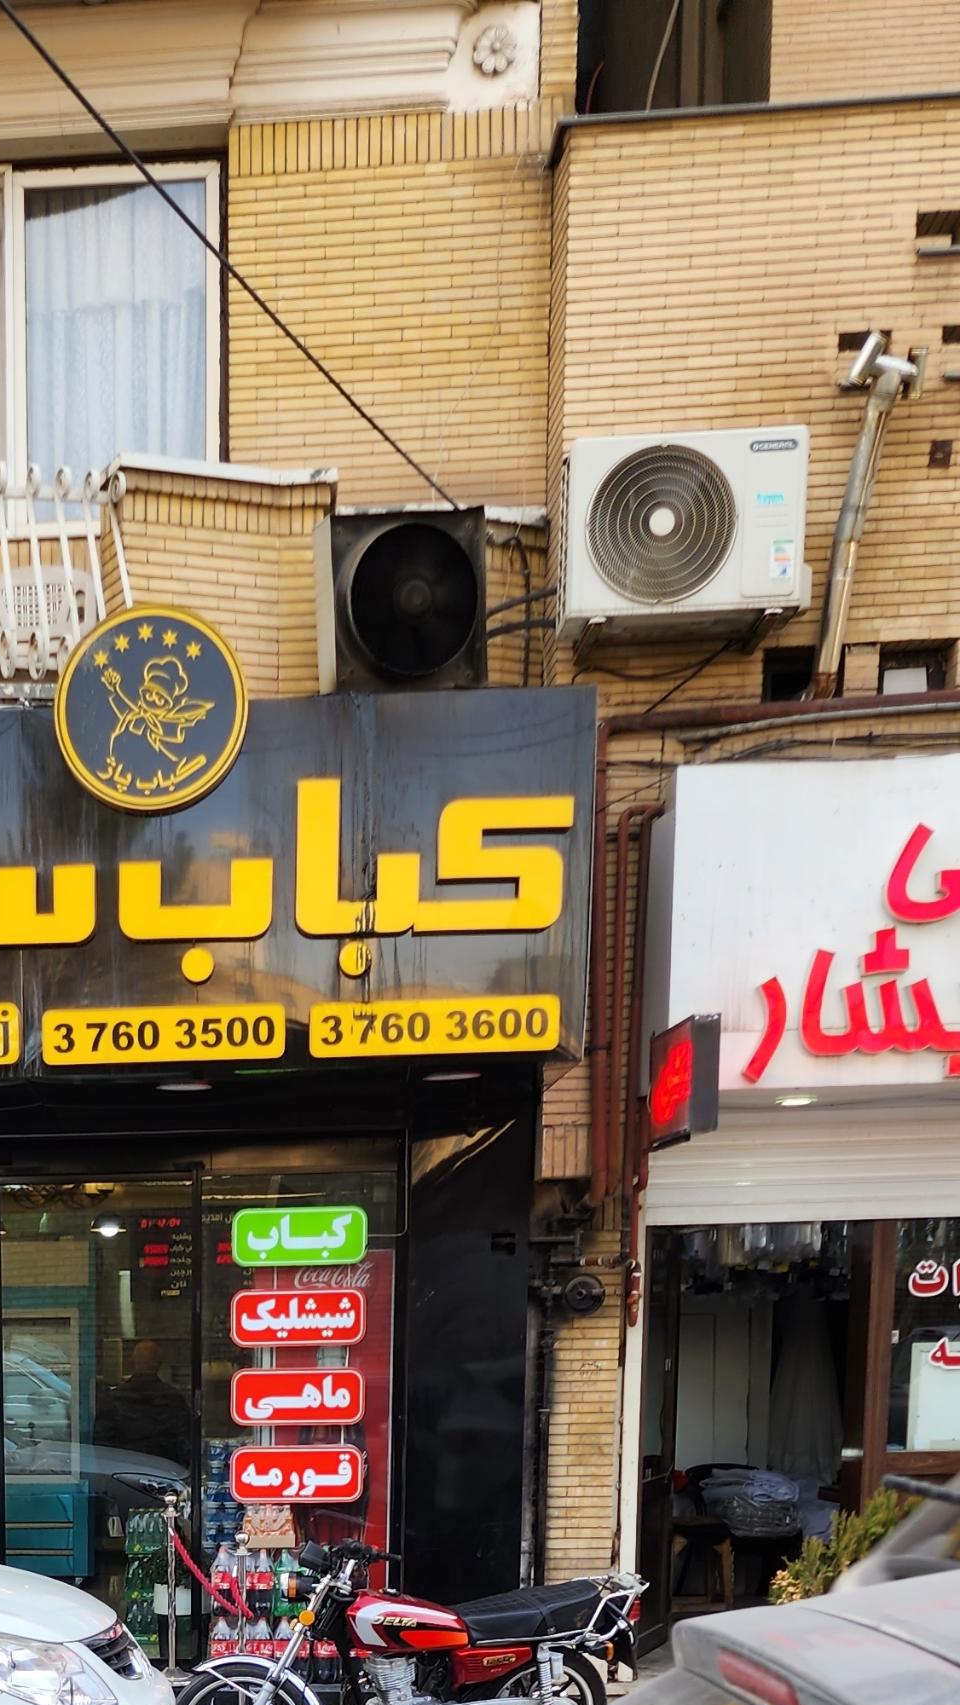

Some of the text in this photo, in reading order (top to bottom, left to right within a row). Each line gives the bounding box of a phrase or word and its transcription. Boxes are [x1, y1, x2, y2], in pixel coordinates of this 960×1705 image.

[96, 754, 207, 796] کباب پاژ
[118, 777, 576, 984] کباب
[175, 1016, 275, 1050] 3500
[445, 1007, 549, 1041] 3600
[248, 1213, 353, 1260] کباب
[241, 1297, 356, 1338] شیشلیک
[245, 1374, 351, 1419] ماهی
[241, 1453, 352, 1496] قورمه
[372, 1616, 418, 1628] DELTA
